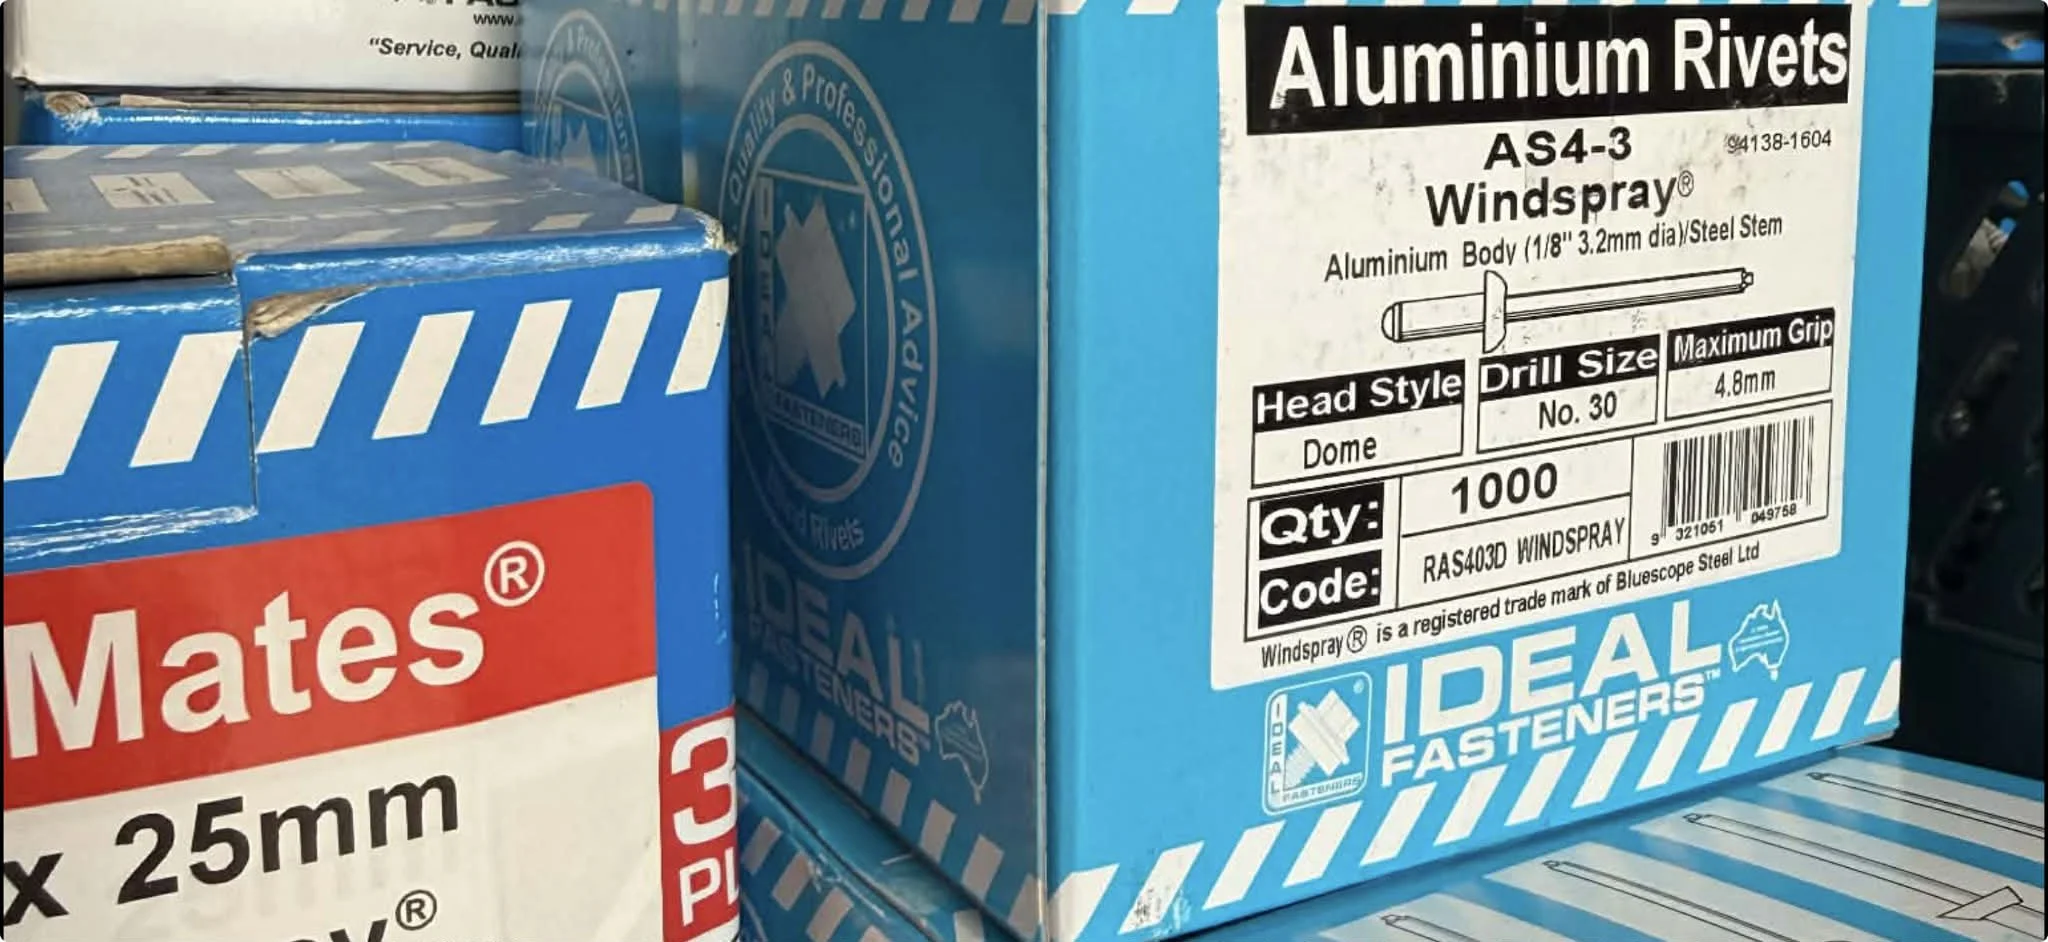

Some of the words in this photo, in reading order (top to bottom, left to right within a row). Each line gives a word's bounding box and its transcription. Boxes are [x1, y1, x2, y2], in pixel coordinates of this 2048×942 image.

[1269, 21, 1650, 110] Aluminium
[1673, 17, 1849, 91] Rivets
[1484, 127, 1632, 170] AS4-3
[782, 67, 796, 107] &
[801, 63, 919, 284] Professional
[887, 298, 925, 469] Advice
[1324, 246, 1448, 282] Aluminium
[1462, 237, 1517, 267] Body
[1524, 231, 1572, 264] (1/8"
[1577, 228, 1642, 255] 3.2mm
[1739, 213, 1783, 239] Stem
[1480, 353, 1563, 394] Drill
[1577, 345, 1659, 381] Size
[1673, 330, 1782, 363] Maximum
[1788, 316, 1833, 348] Grip
[1256, 382, 1357, 425] Head
[1370, 369, 1462, 410] Style
[1538, 397, 1580, 430] No.
[1590, 391, 1617, 422] 30
[1714, 367, 1776, 398] 4.8mm
[1303, 435, 1377, 469] Dome
[1261, 499, 1379, 547] Qty:
[1451, 462, 1557, 514] 1000
[1651, 533, 1660, 546] 9
[1675, 519, 1723, 541] 321051
[1751, 503, 1797, 524] 049758
[1260, 567, 1379, 615] Code:
[1422, 541, 1506, 584] RAS403D
[1518, 517, 1626, 565] WINDSPRAY
[1376, 622, 1392, 643] is
[1398, 625, 1408, 638] a
[1413, 597, 1501, 637] registered
[1504, 589, 1546, 615] trade
[1551, 579, 1592, 606] mark
[1596, 574, 1612, 595] of
[1616, 559, 1693, 591] Bluescope
[1698, 548, 1733, 572] Steel
[1738, 540, 1760, 563] Ltd
[743, 540, 930, 734] IDEAL
[1382, 599, 1720, 747] IDEAL
[1270, 703, 1284, 794] IDEAL
[115, 773, 459, 904] 25mm
